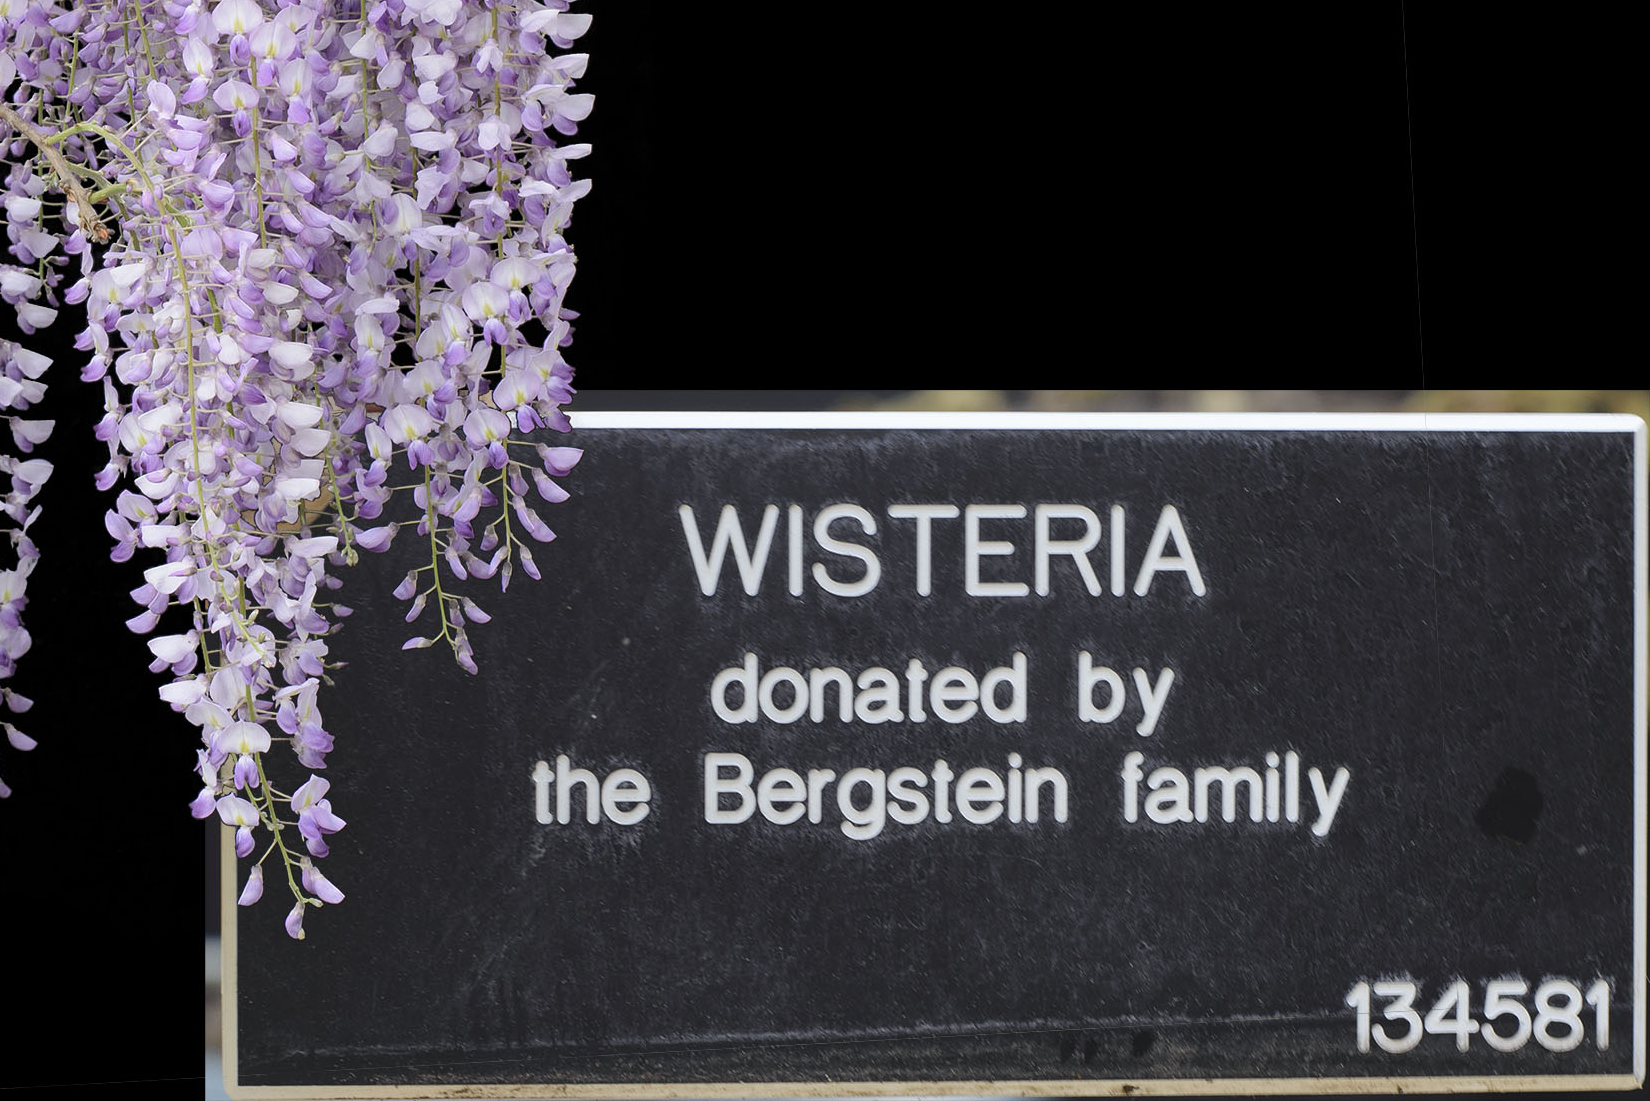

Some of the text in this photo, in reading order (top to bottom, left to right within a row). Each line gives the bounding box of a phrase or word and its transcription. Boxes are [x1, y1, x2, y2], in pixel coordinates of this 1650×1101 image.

[678, 503, 1207, 598] WISTERIA
[710, 649, 1177, 738] donated by
[531, 749, 1352, 841] the Bergstein family
[1345, 973, 1612, 1054] 134581
